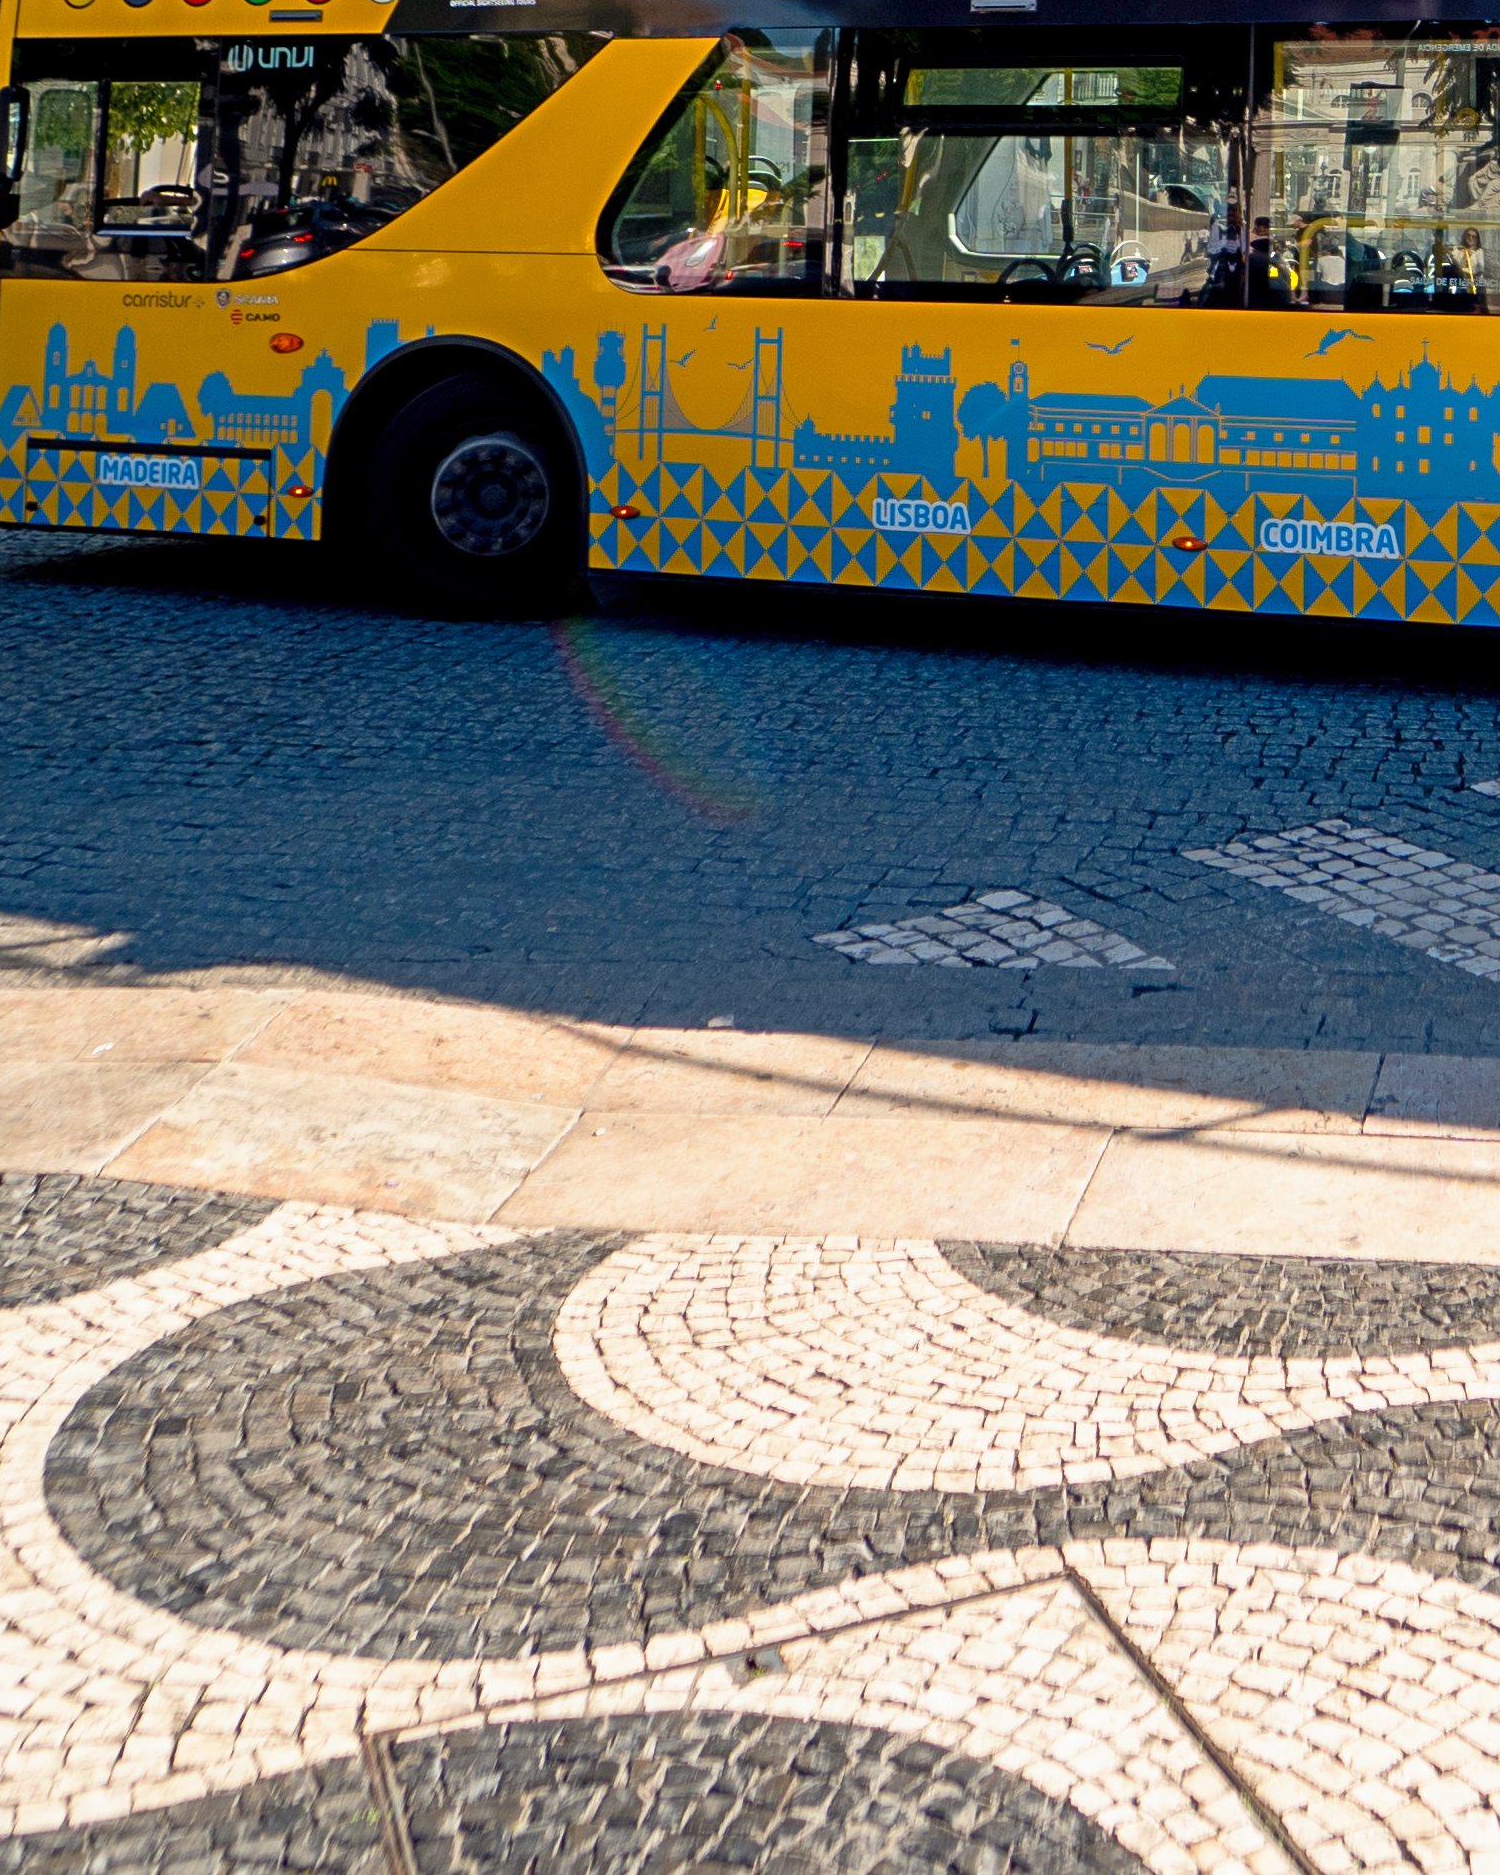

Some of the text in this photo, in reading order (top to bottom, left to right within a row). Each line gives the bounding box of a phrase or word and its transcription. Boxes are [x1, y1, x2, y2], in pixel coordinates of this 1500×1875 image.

[122, 290, 192, 308] carristur
[100, 457, 201, 489] MADEIRA
[872, 500, 971, 532] LISBOA
[1262, 521, 1398, 556] COIMBRA
